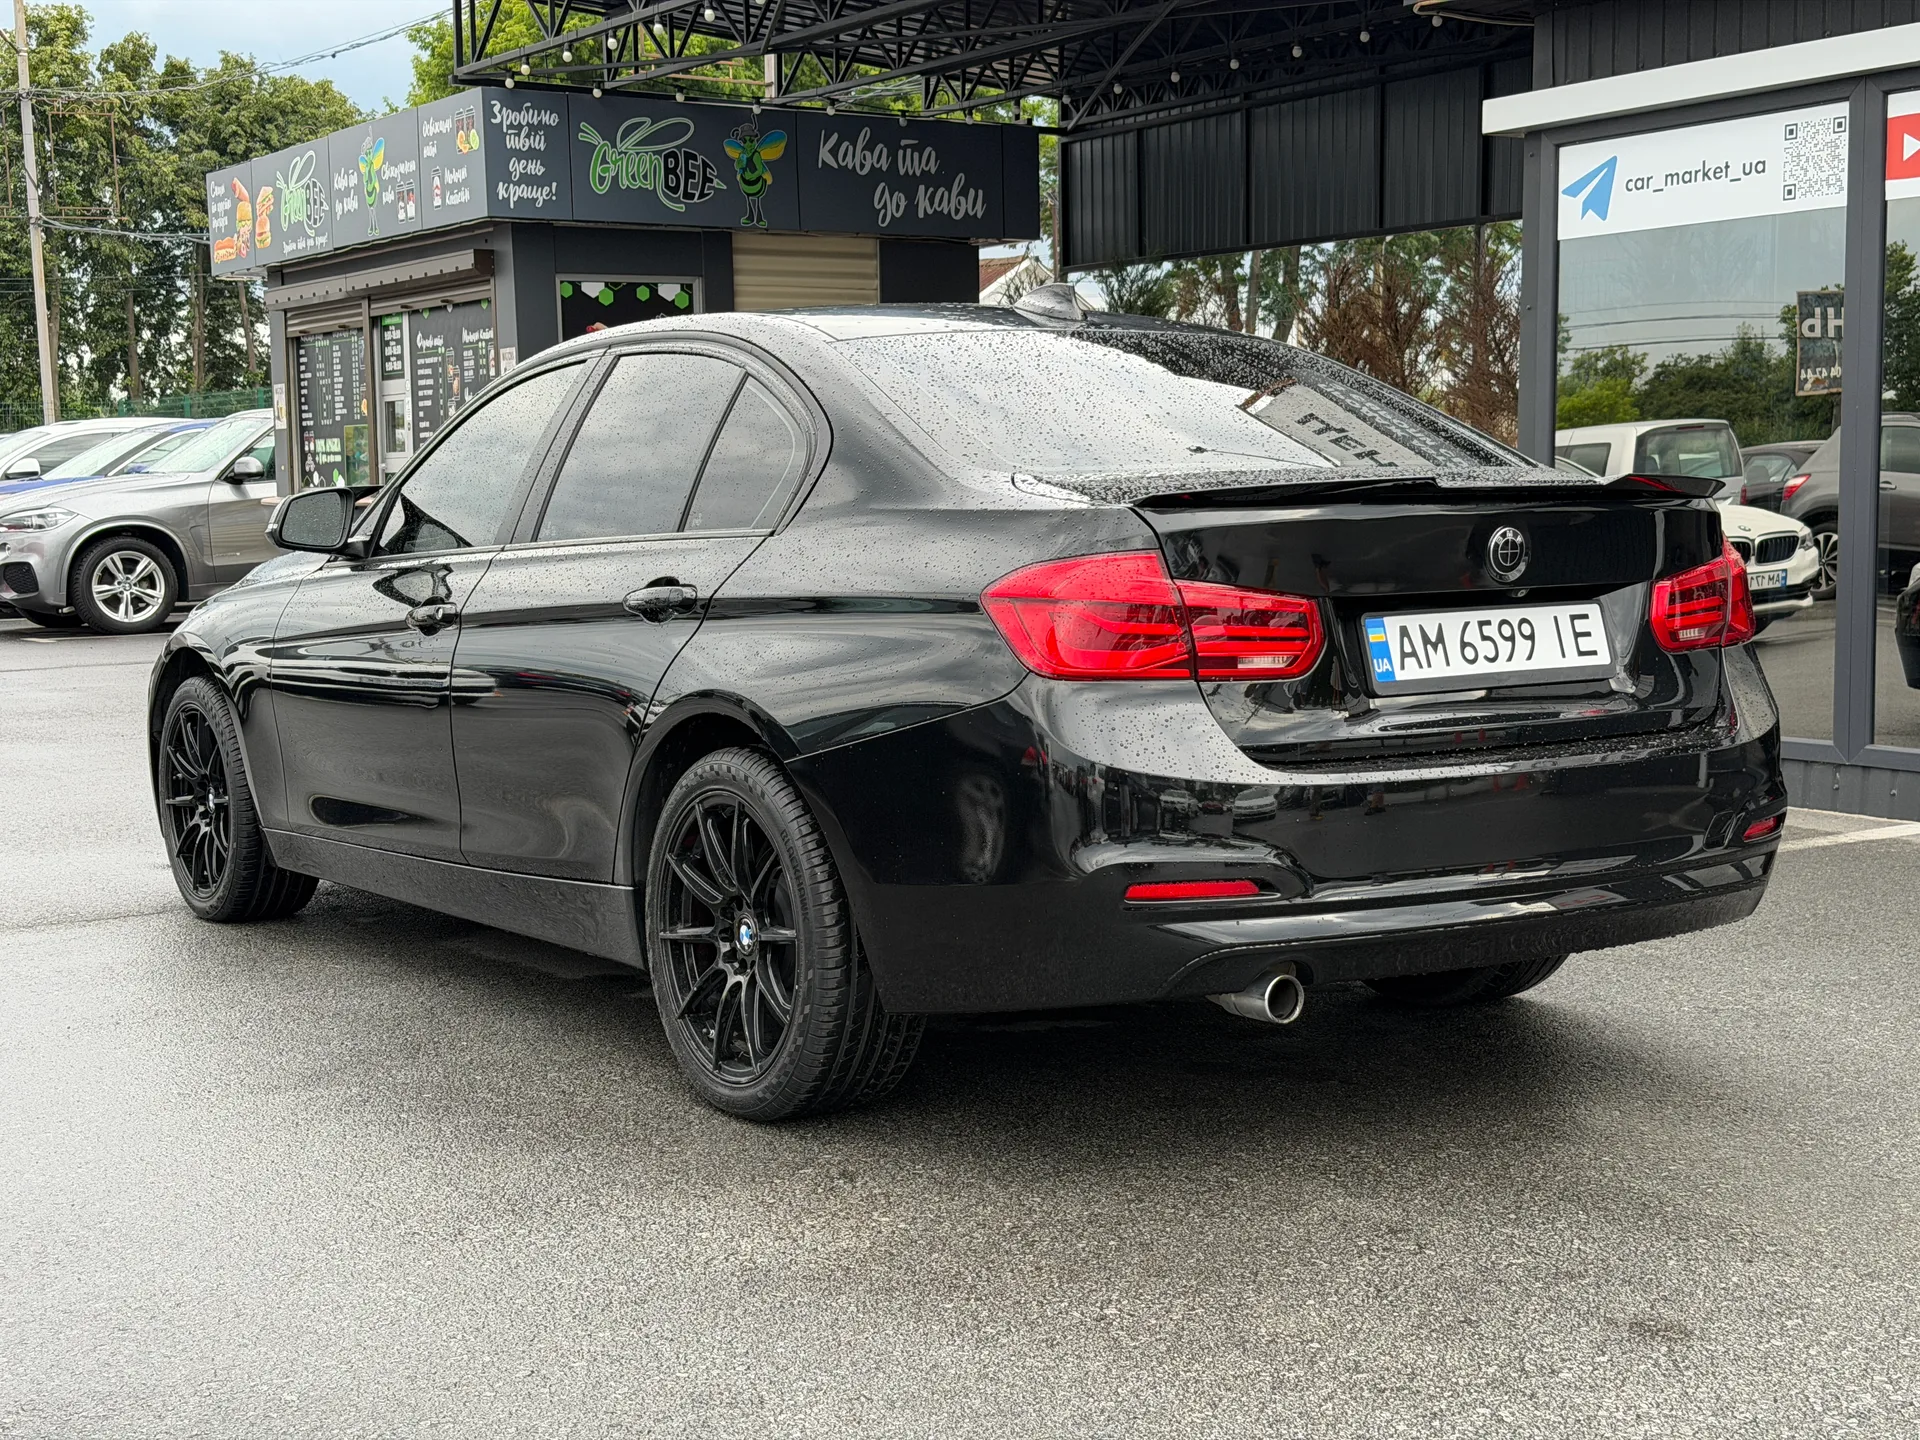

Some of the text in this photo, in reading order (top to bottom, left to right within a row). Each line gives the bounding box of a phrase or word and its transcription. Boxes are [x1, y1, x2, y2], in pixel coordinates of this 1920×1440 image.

[490, 100, 559, 133] Зробимо
[505, 126, 547, 151] твій
[818, 126, 940, 177] Кава та
[509, 157, 546, 181] день
[1625, 159, 1767, 193] car_market_ua
[496, 181, 558, 210] краще!
[873, 173, 987, 228] до кави
[1398, 613, 1598, 671] AM 6599 IE
[1373, 658, 1392, 674] UA
